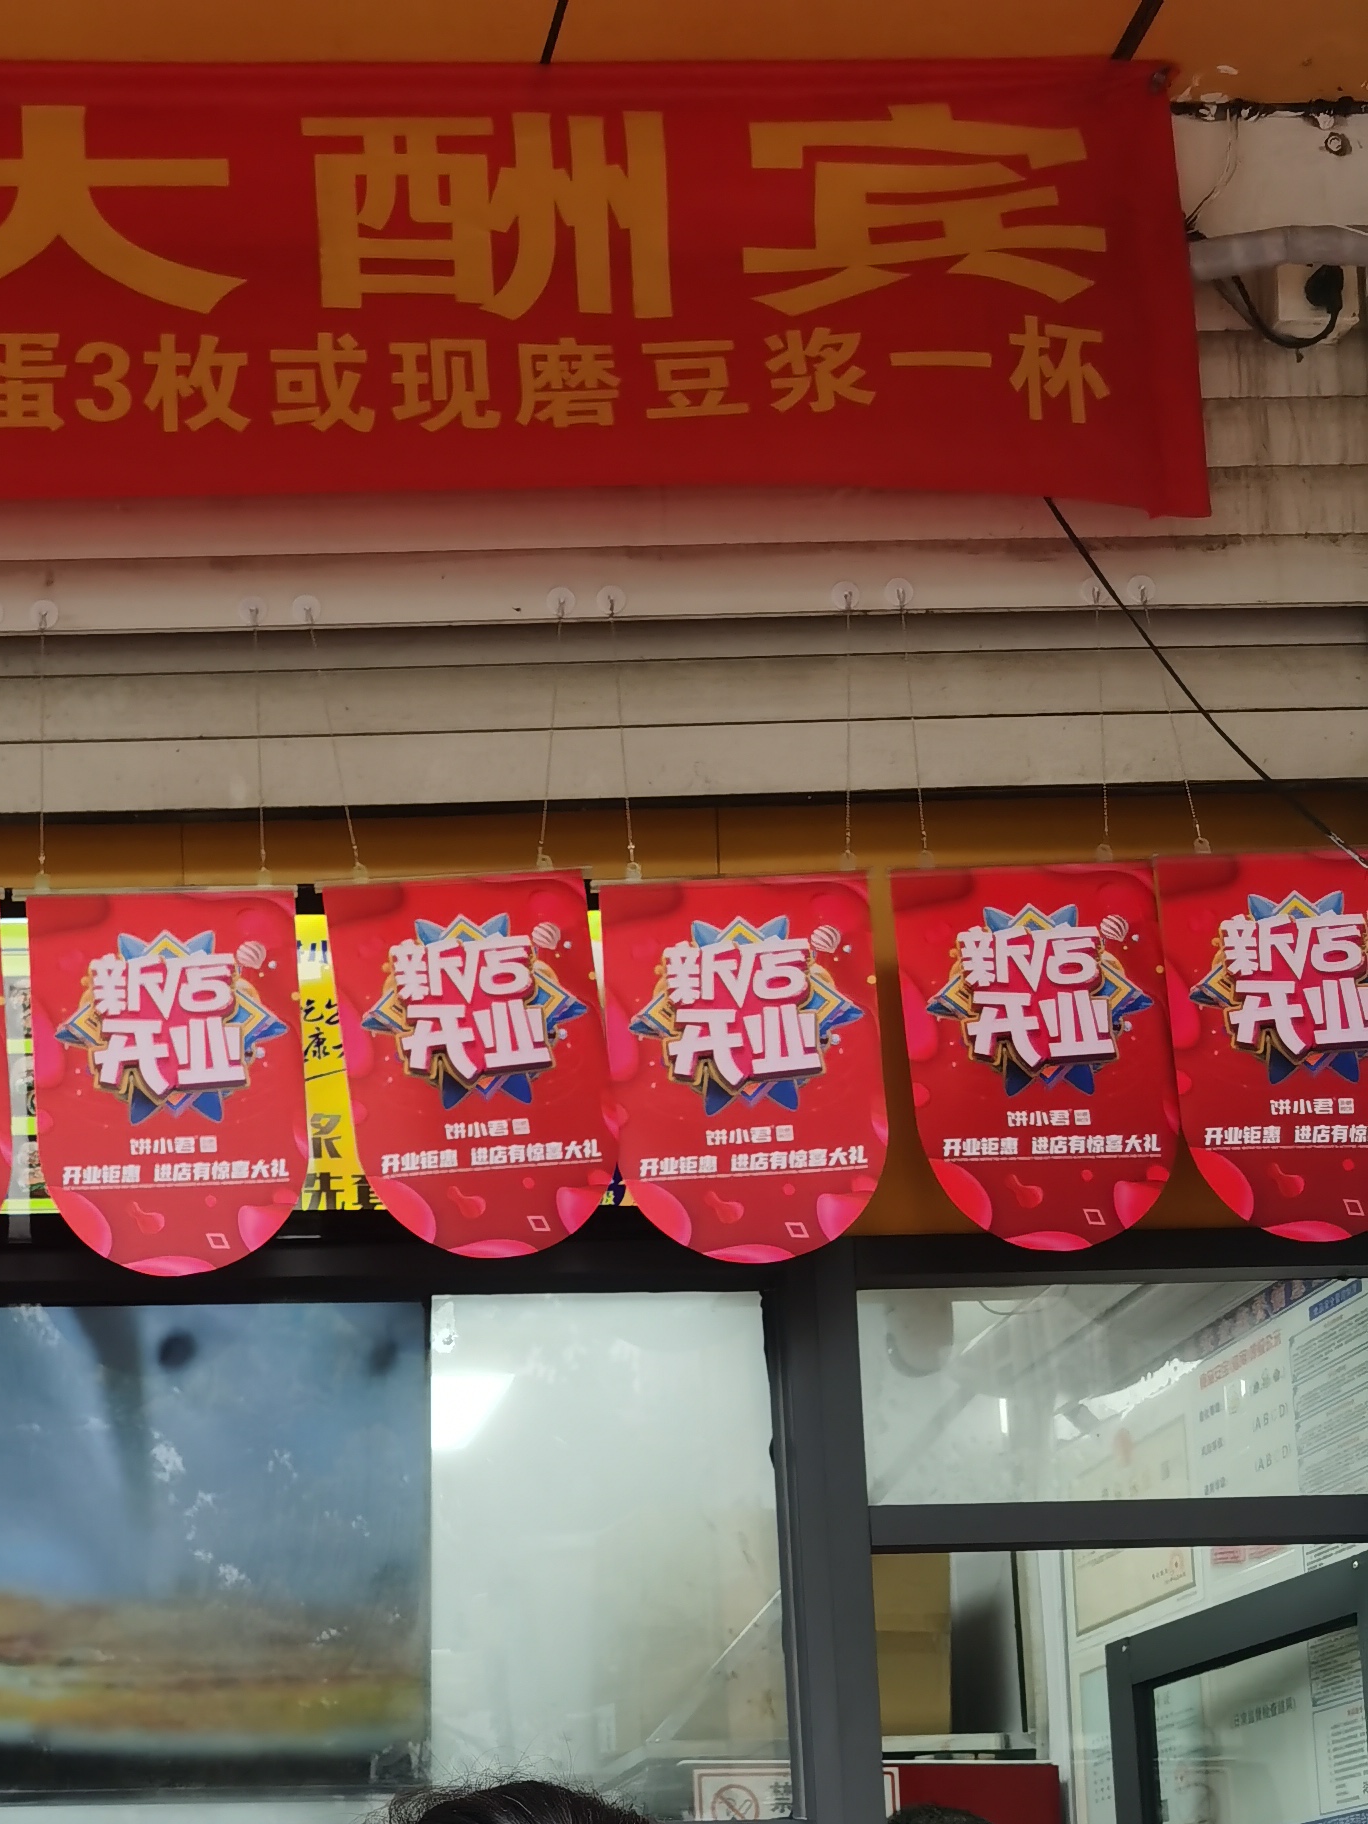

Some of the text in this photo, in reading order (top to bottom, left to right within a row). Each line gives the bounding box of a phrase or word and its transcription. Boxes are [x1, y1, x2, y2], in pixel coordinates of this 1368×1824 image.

[388, 934, 534, 1003] 新店
[663, 937, 812, 1007] 新店
[955, 923, 1098, 991] 新店
[1223, 912, 1368, 976] 新店
[88, 950, 236, 1019] 新店
[1230, 976, 1368, 1054] 开业
[94, 1017, 248, 1096] 开业
[401, 1001, 551, 1082] 开业
[665, 1003, 821, 1086] 开业
[965, 988, 1115, 1070] 开业
[1294, 1124, 1368, 1144] 进店有惊
